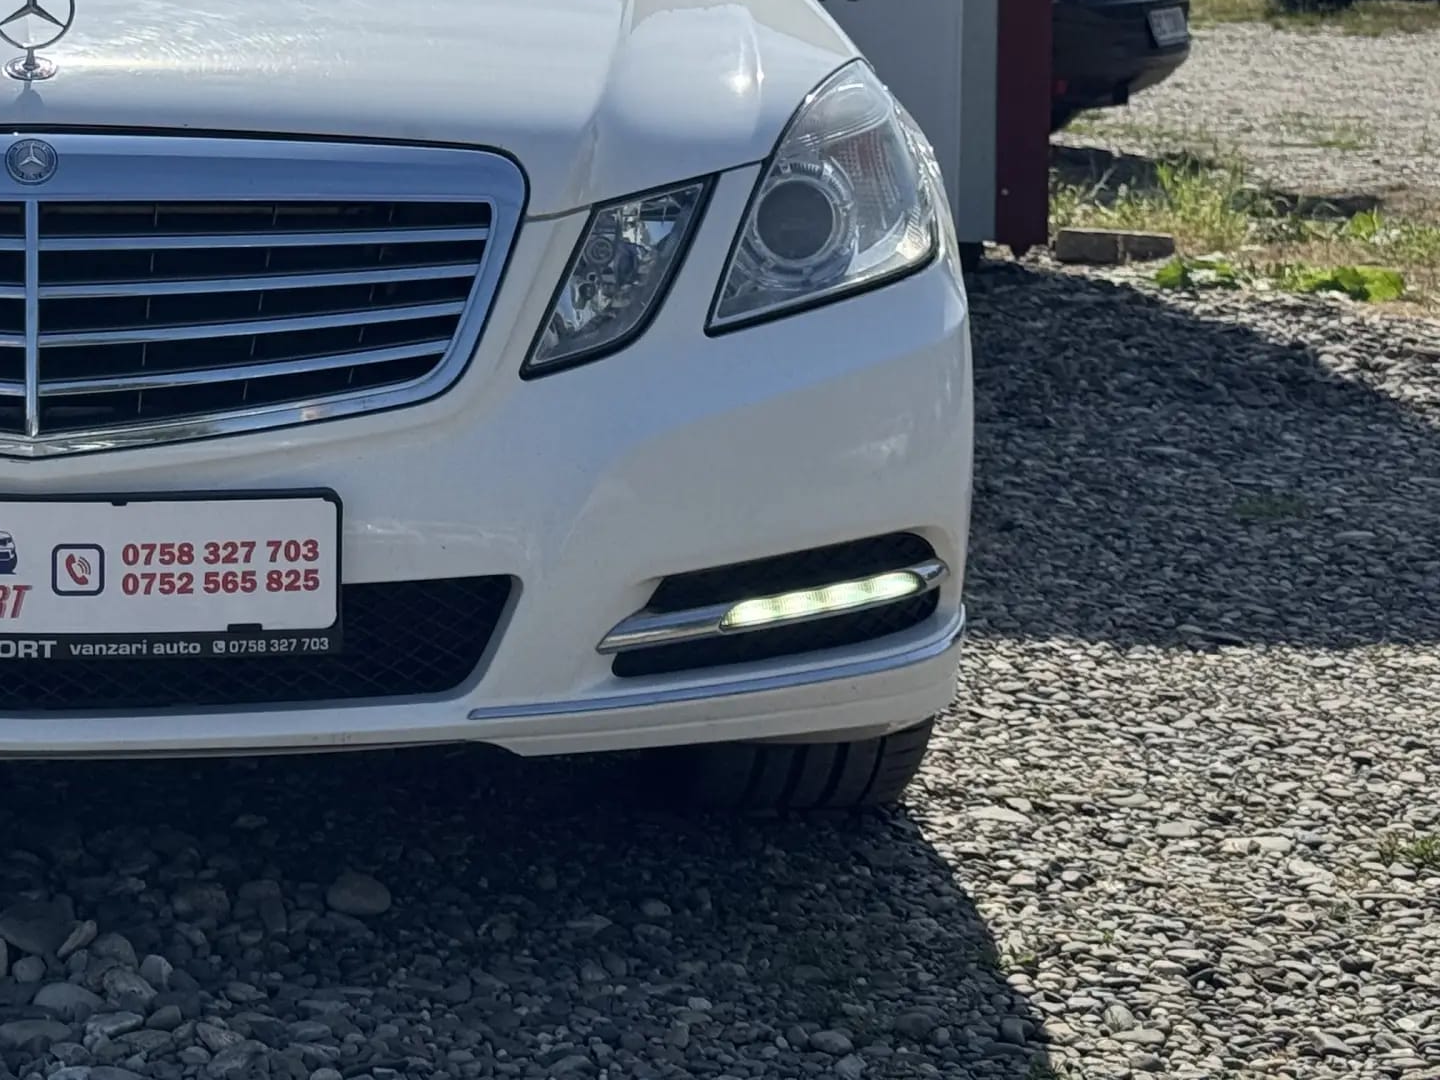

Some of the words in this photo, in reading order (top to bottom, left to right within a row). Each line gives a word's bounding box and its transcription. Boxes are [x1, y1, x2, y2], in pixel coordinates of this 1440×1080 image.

[121, 542, 195, 566] 0758
[203, 541, 257, 565] 327
[266, 539, 319, 563] 703
[121, 572, 194, 596] 0752
[203, 570, 257, 594] 565
[265, 568, 319, 592] 825
[69, 639, 148, 656] vanzari
[152, 640, 202, 655] auto
[229, 639, 266, 653] 0758
[270, 638, 297, 652] 327
[301, 637, 330, 652] 703
